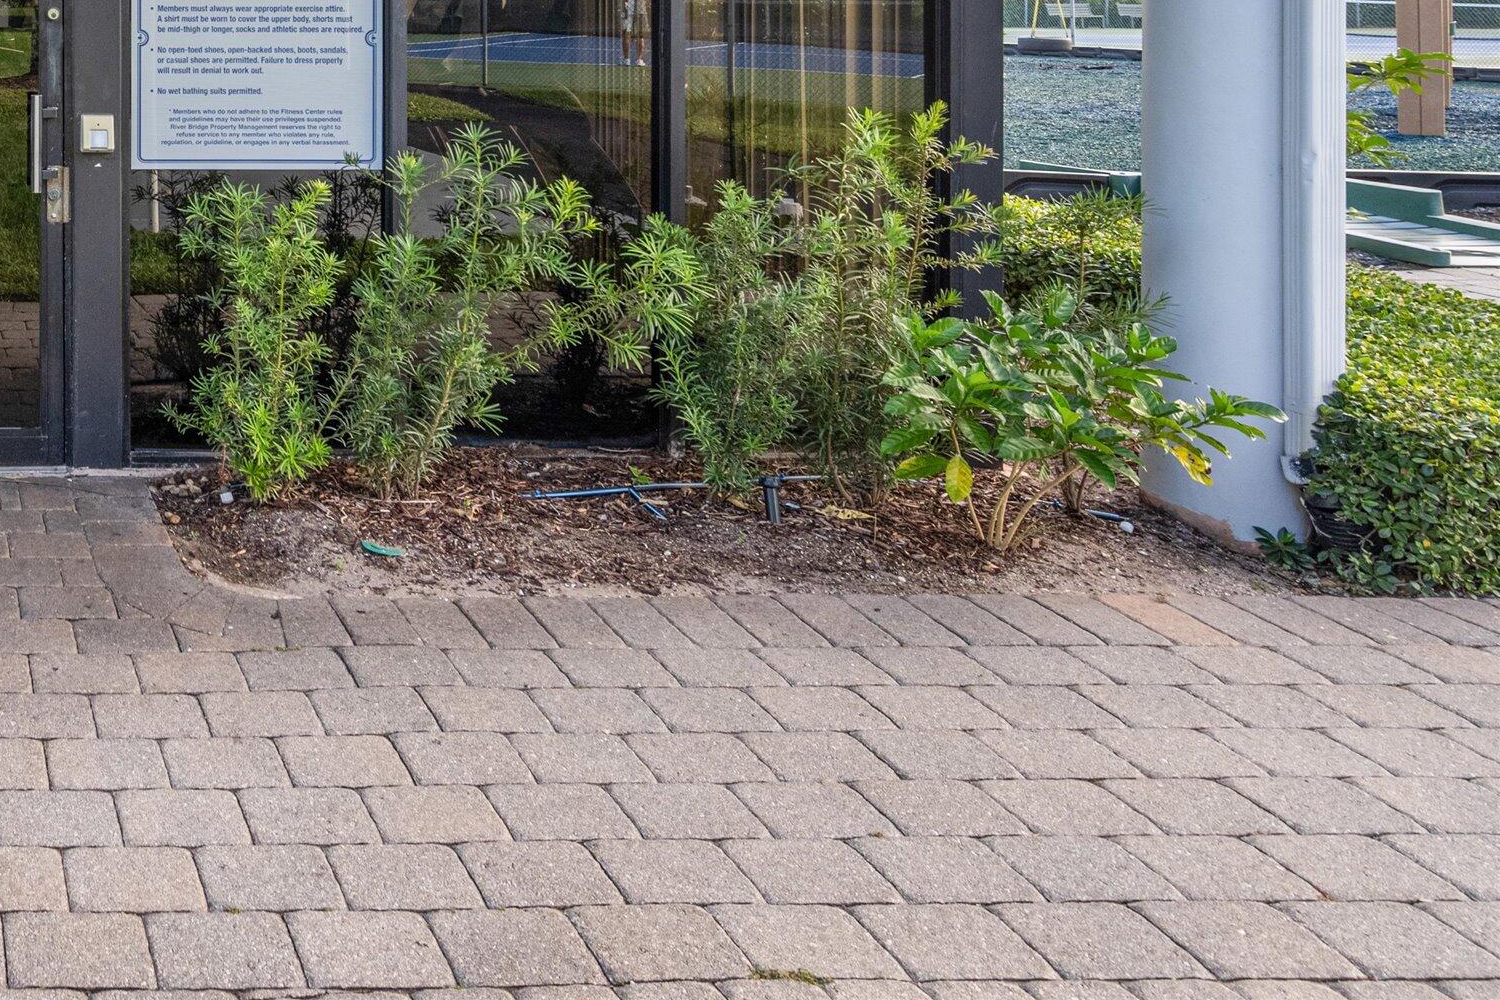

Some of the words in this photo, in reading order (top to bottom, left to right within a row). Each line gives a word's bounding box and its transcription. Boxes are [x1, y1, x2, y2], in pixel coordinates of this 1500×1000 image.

[210, 5, 234, 13] always
[254, 5, 293, 13] appropriate
[293, 16, 311, 24] body,
[168, 26, 201, 34] mid-thigh
[211, 26, 234, 34] longer,
[236, 25, 256, 33] socks
[272, 25, 297, 33] athletic
[168, 46, 203, 55] open-toed
[204, 46, 226, 54] shoes,
[228, 46, 272, 55] open-backed
[274, 46, 296, 54] shoes,
[298, 46, 318, 54] boots,
[261, 56, 284, 64] Failure
[315, 57, 343, 65] properly
[182, 88, 209, 96] bathing
